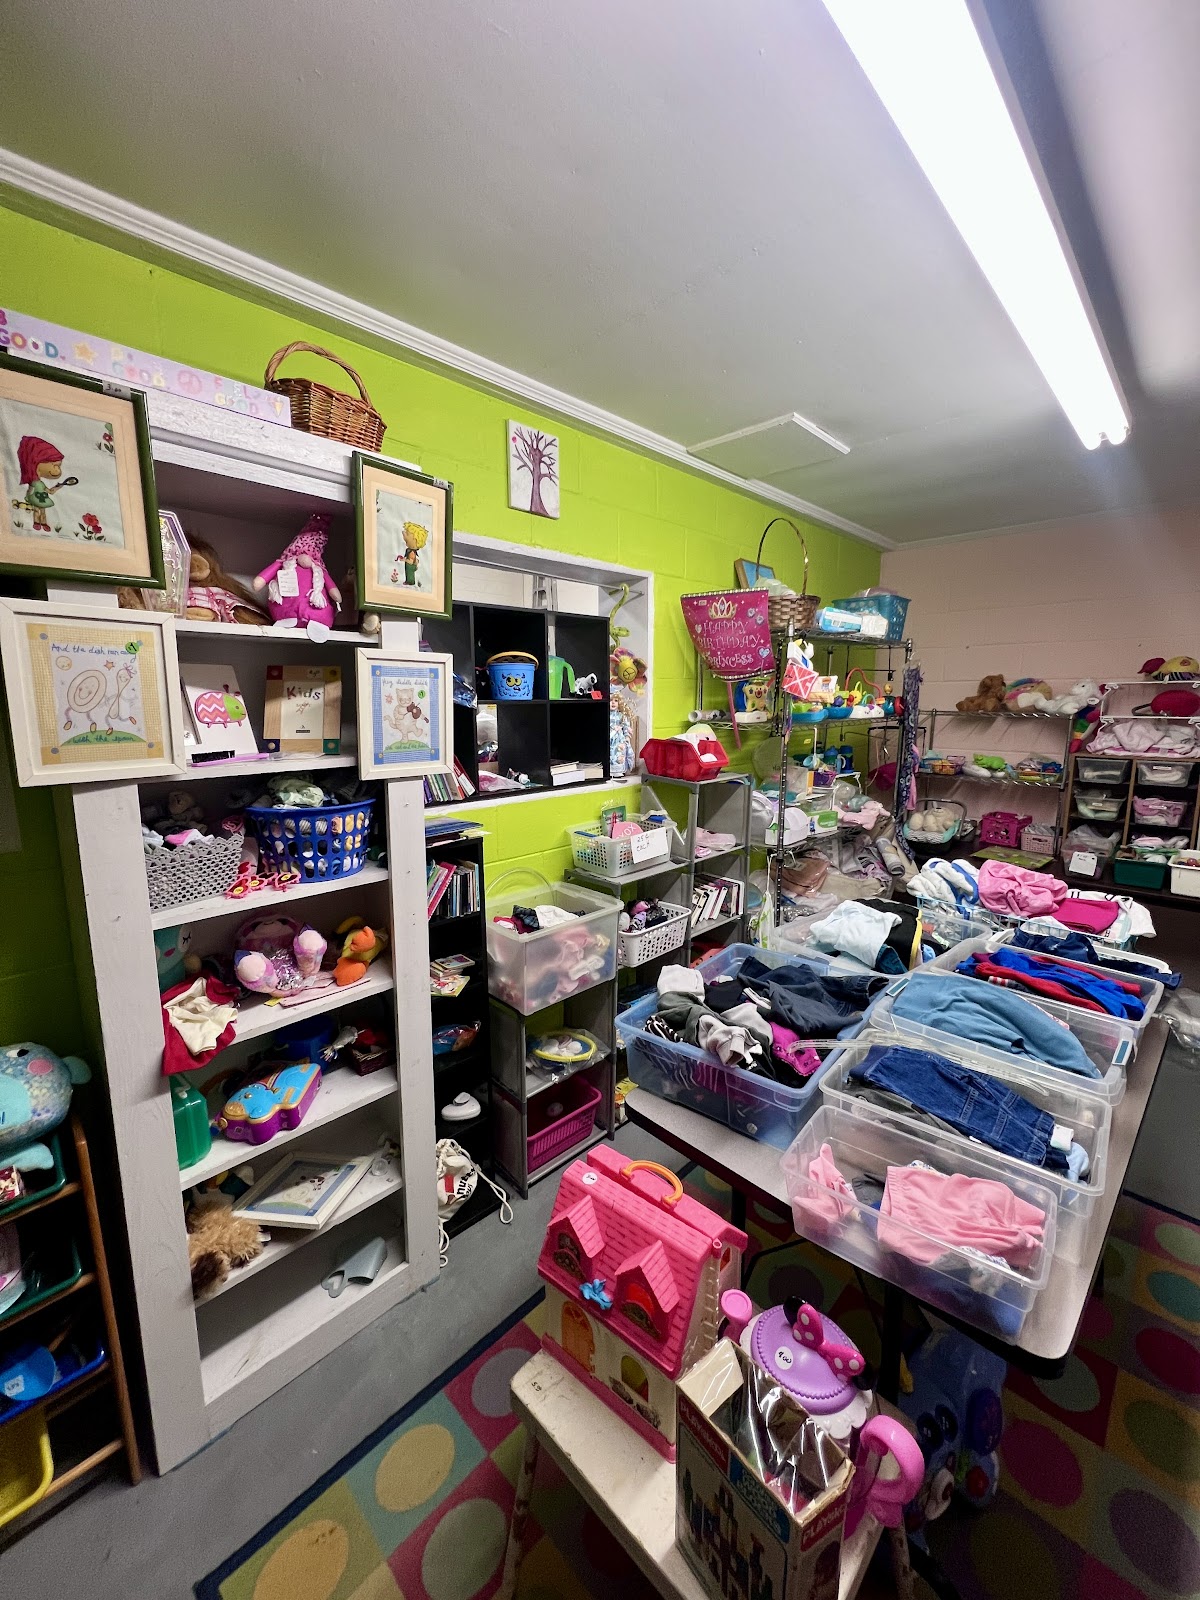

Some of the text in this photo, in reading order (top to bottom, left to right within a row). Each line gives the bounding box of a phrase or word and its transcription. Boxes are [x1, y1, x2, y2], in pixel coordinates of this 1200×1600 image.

[703, 620, 749, 635] HAPPY
[697, 634, 761, 650] BIRTHDAY
[708, 653, 754, 668] PRINCESS
